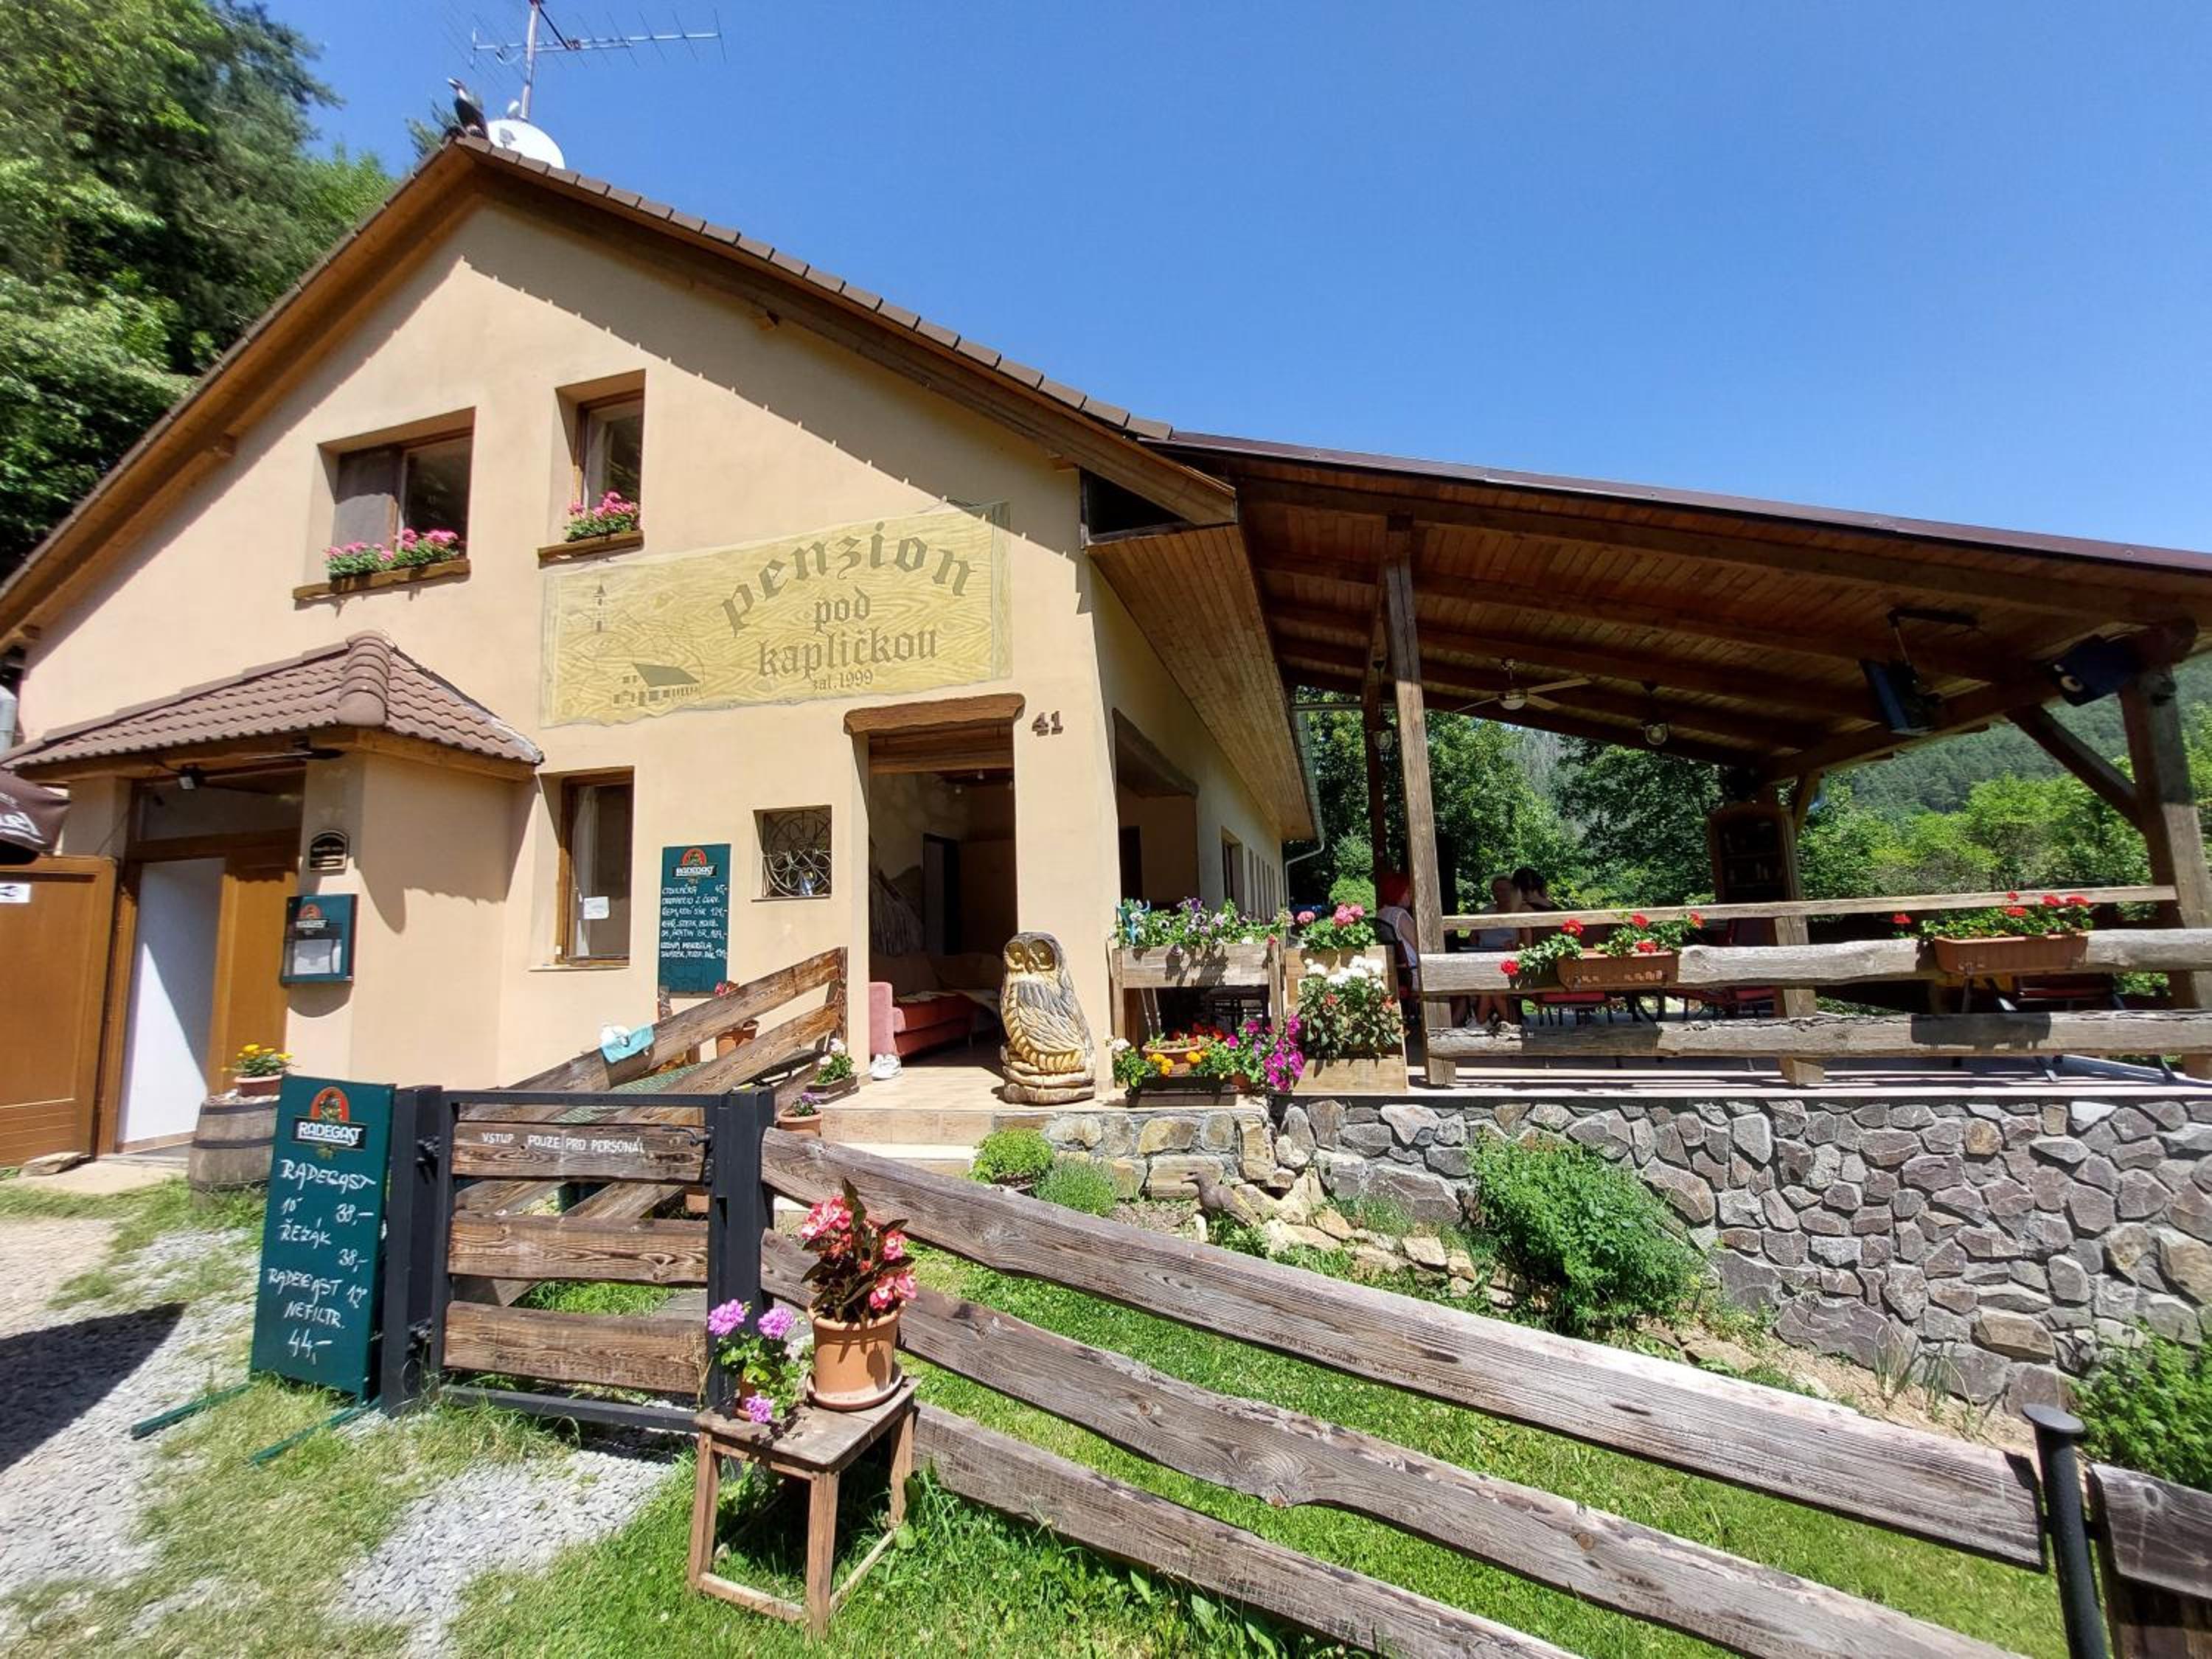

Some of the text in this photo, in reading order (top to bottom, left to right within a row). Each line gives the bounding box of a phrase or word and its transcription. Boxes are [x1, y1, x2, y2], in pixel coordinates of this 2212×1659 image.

[722, 521, 977, 639] penzion
[813, 586, 871, 635] pod
[758, 627, 937, 680] kapličkou
[1032, 710, 1063, 737] 41
[298, 1121, 363, 1147] RADEGAST
[481, 1132, 645, 1154] VSTUP POUZE PRO PERSONÁL
[278, 1158, 377, 1195] RADEGAST
[278, 1217, 332, 1250] ŘEZÁK
[266, 1267, 344, 1306] RADEGAST
[283, 1300, 346, 1329] NEFILTR.
